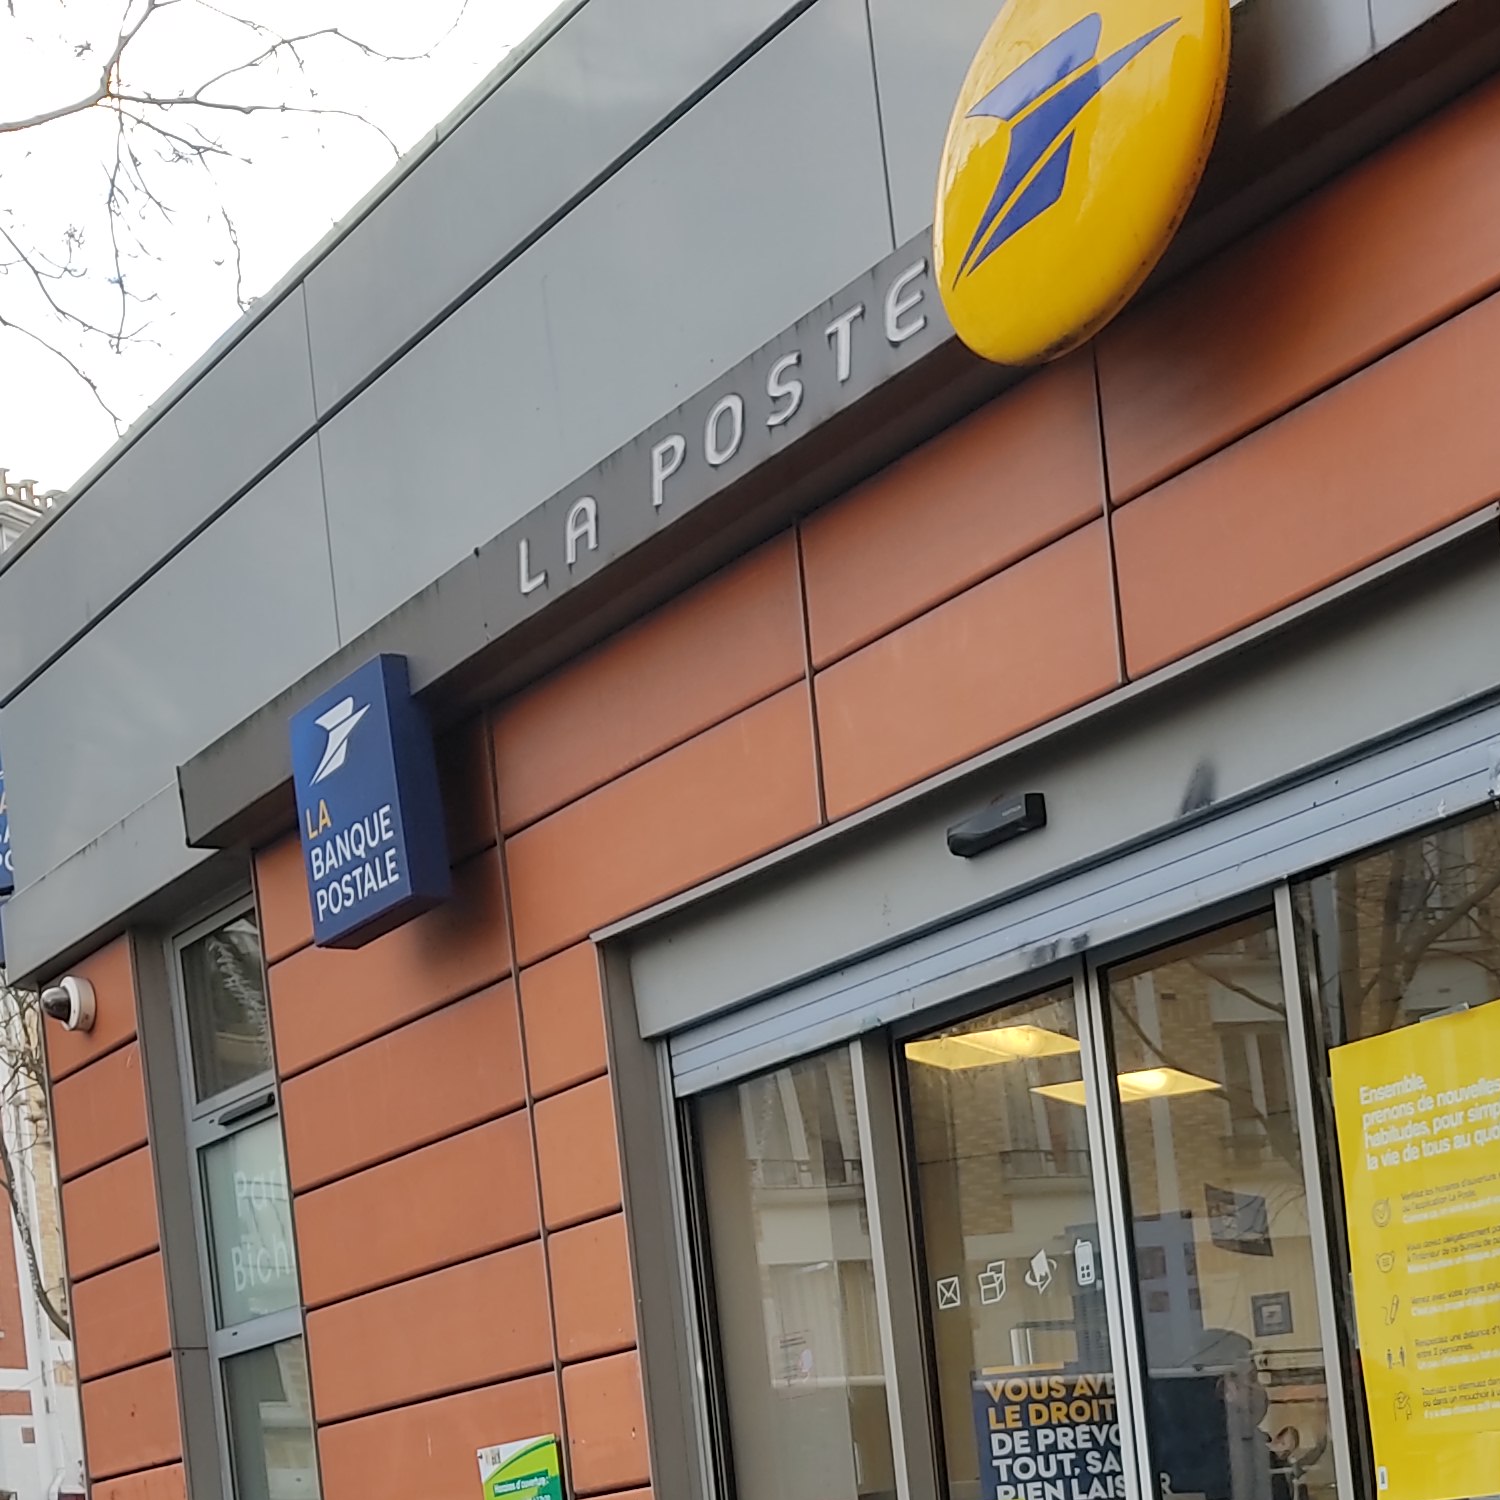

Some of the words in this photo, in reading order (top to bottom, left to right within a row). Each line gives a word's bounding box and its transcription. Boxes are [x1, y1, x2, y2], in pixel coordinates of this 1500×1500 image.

[519, 497, 598, 595] LA
[650, 257, 929, 508] POSTE
[305, 798, 332, 840] LA
[310, 804, 394, 881] BANQUE
[316, 847, 400, 923] POSTALE
[1360, 1073, 1428, 1105] Ensemble,
[1363, 1101, 1415, 1130] prenons
[1417, 1095, 1434, 1113] de
[1433, 1111, 1464, 1135] pour
[1366, 1152, 1379, 1171] la
[1381, 1148, 1400, 1168] vie
[1402, 1143, 1419, 1163] de
[1422, 1136, 1451, 1158] tous
[1453, 1132, 1471, 1150] au
[231, 1232, 290, 1293] Bich
[984, 1375, 1067, 1404] VOUS
[1072, 1374, 1115, 1397] AVE
[988, 1404, 1022, 1430] LE
[1028, 1397, 1115, 1427] DROIT
[990, 1430, 1031, 1457] DE
[1037, 1423, 1120, 1453] PRÉVO
[992, 1452, 1081, 1482] TOUT,
[1085, 1450, 1122, 1475] SA
